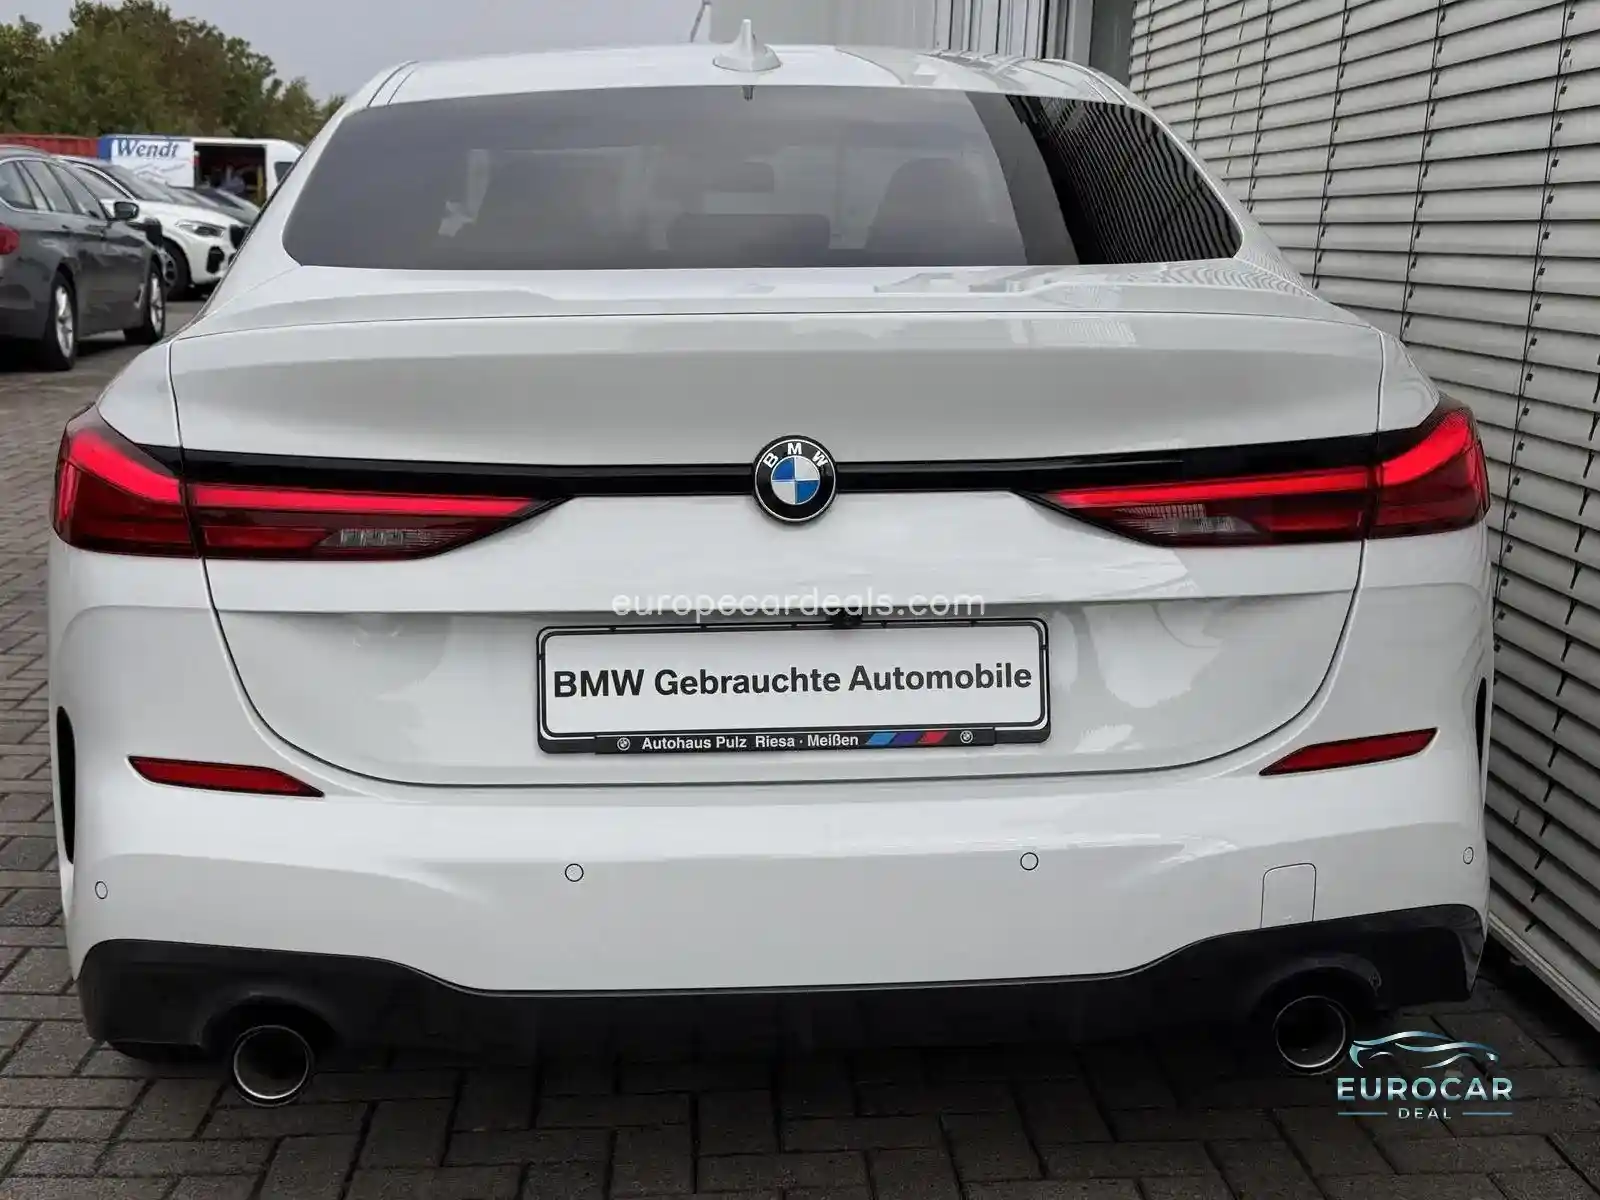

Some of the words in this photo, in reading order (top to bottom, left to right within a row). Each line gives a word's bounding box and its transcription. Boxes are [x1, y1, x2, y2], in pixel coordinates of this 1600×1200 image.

[117, 139, 179, 158] Wendt
[763, 442, 829, 469] BMW
[553, 668, 645, 698] BMW
[654, 666, 841, 696] Gebrauchte
[848, 662, 1032, 692] Automobile
[641, 736, 712, 750] Autohaus
[715, 735, 747, 749] Pulz
[755, 735, 795, 749] Riesa
[807, 733, 859, 747] Meißen
